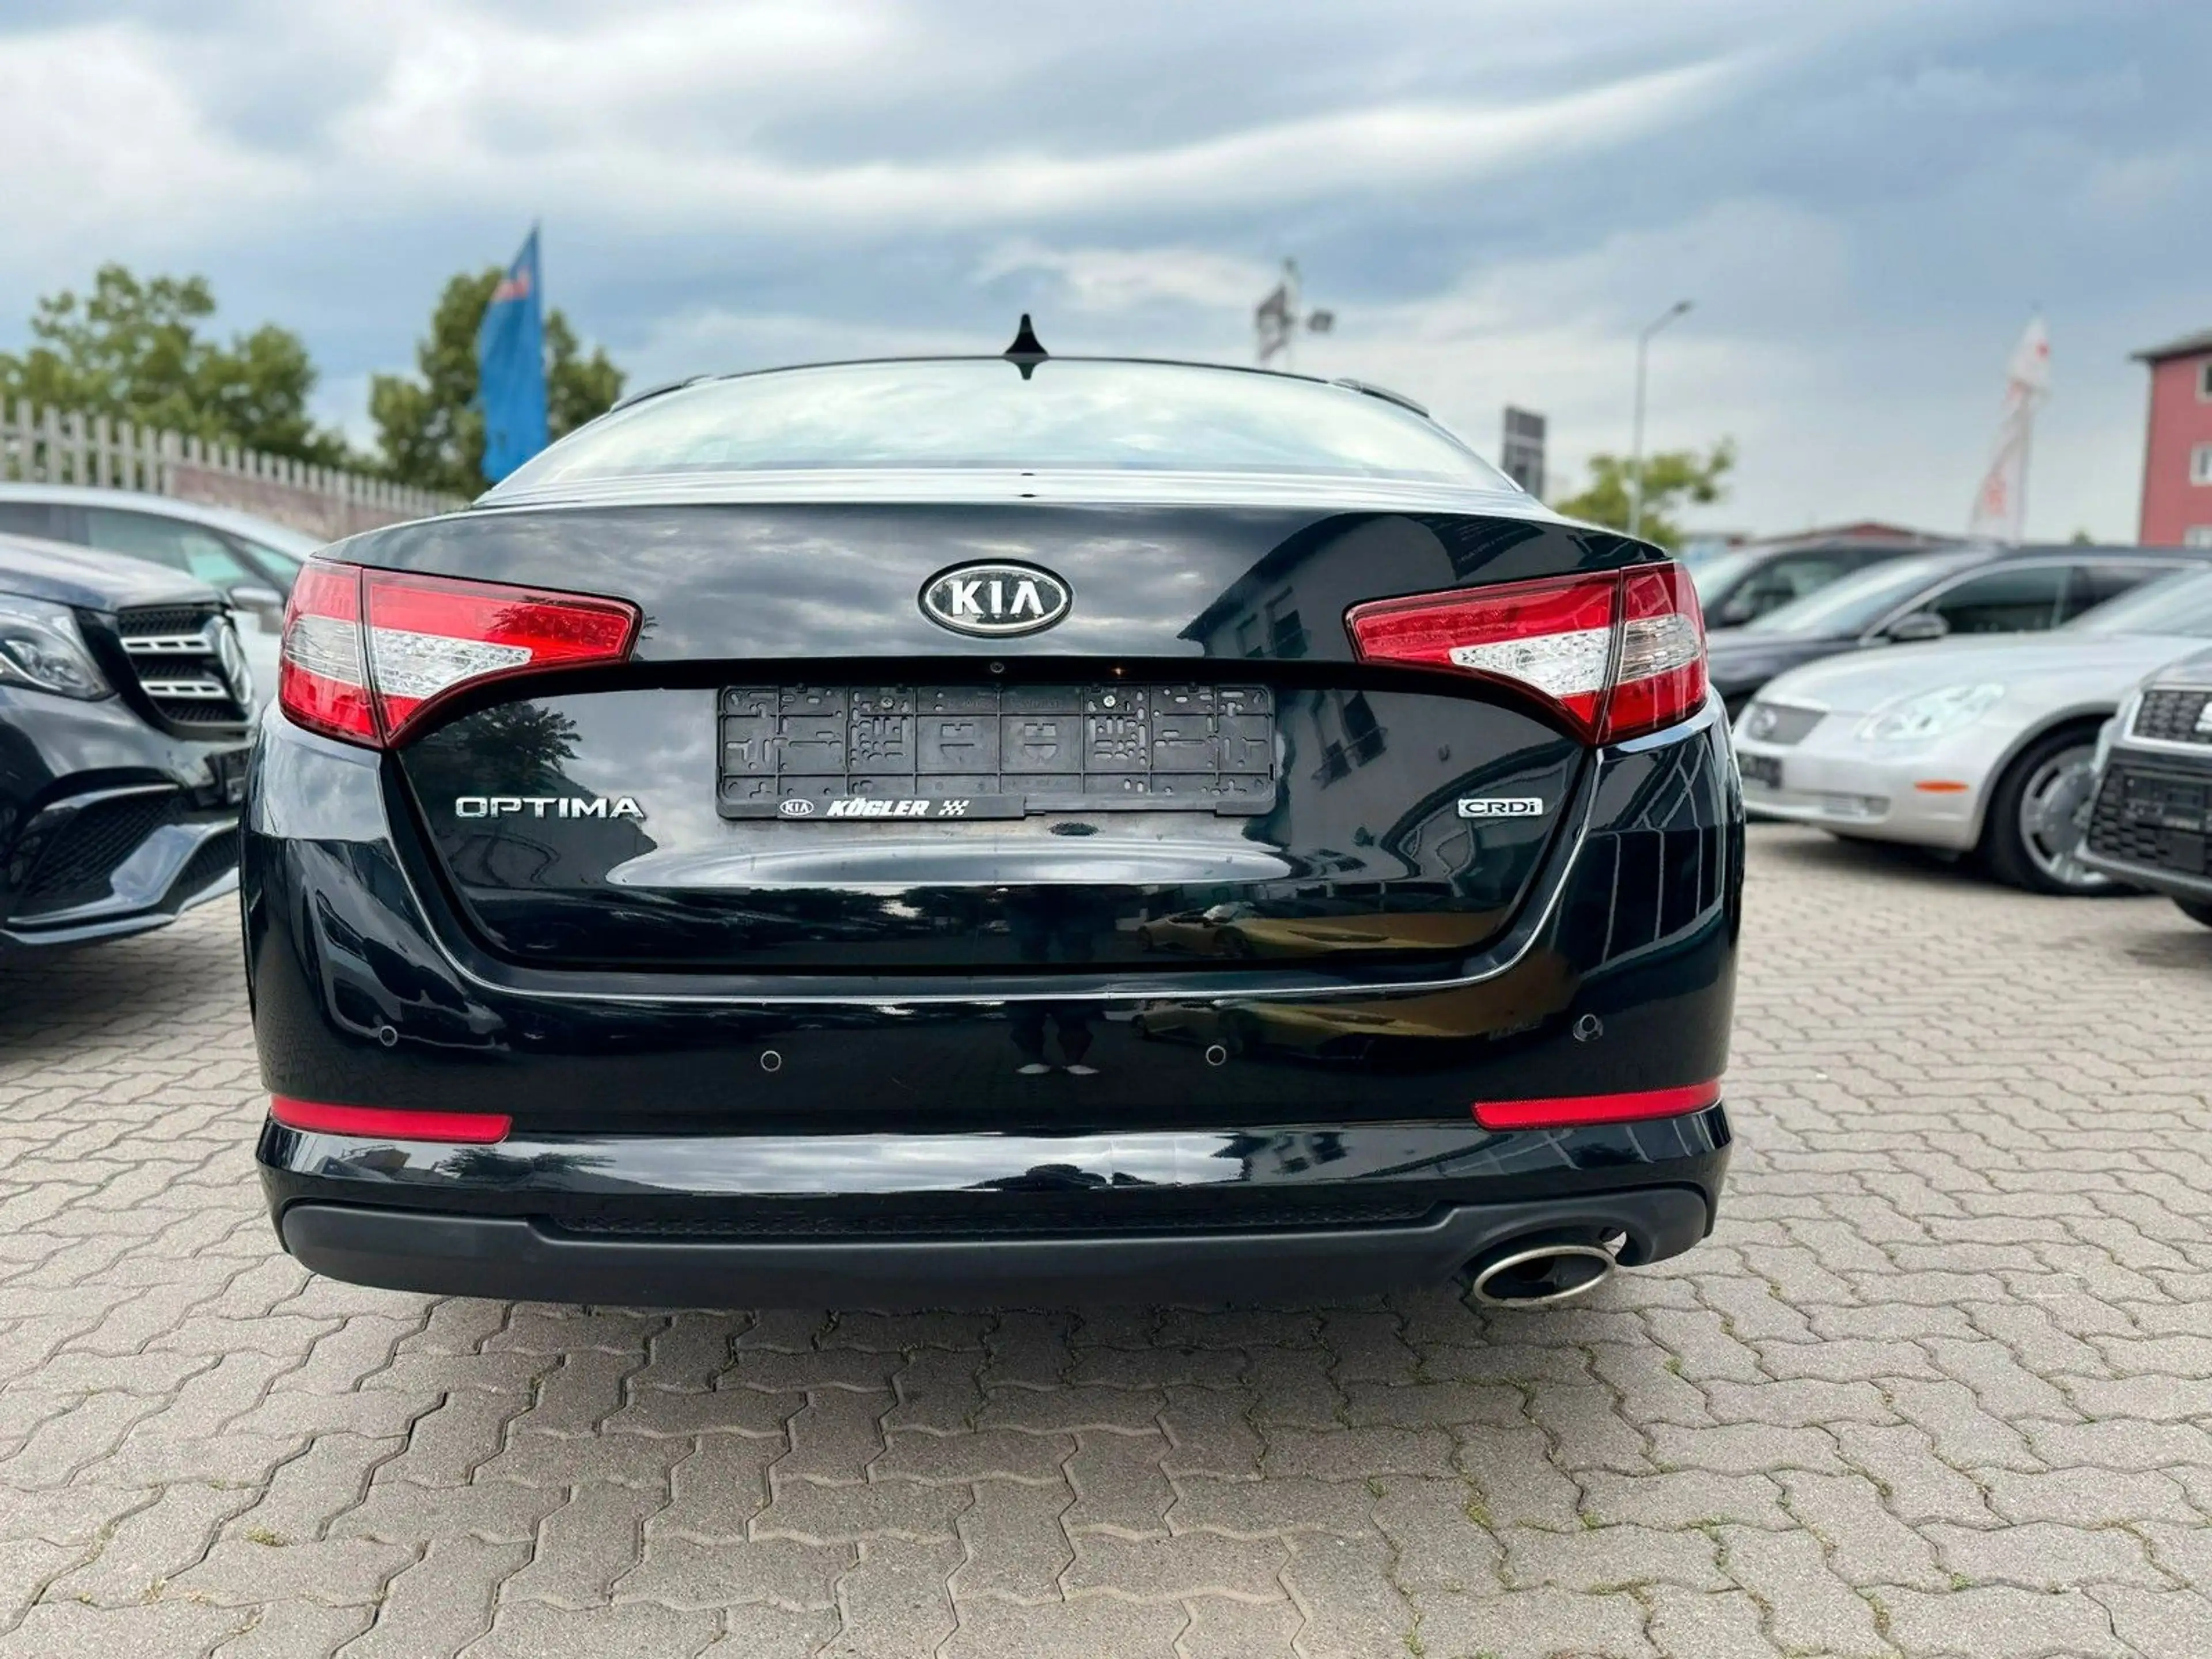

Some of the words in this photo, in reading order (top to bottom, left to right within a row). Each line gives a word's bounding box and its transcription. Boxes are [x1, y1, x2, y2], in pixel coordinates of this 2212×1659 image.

[951, 579, 1044, 615] KIA
[454, 797, 644, 817] OPTIMA
[826, 797, 930, 816] KÖGLER
[1465, 801, 1535, 813] CRDi
